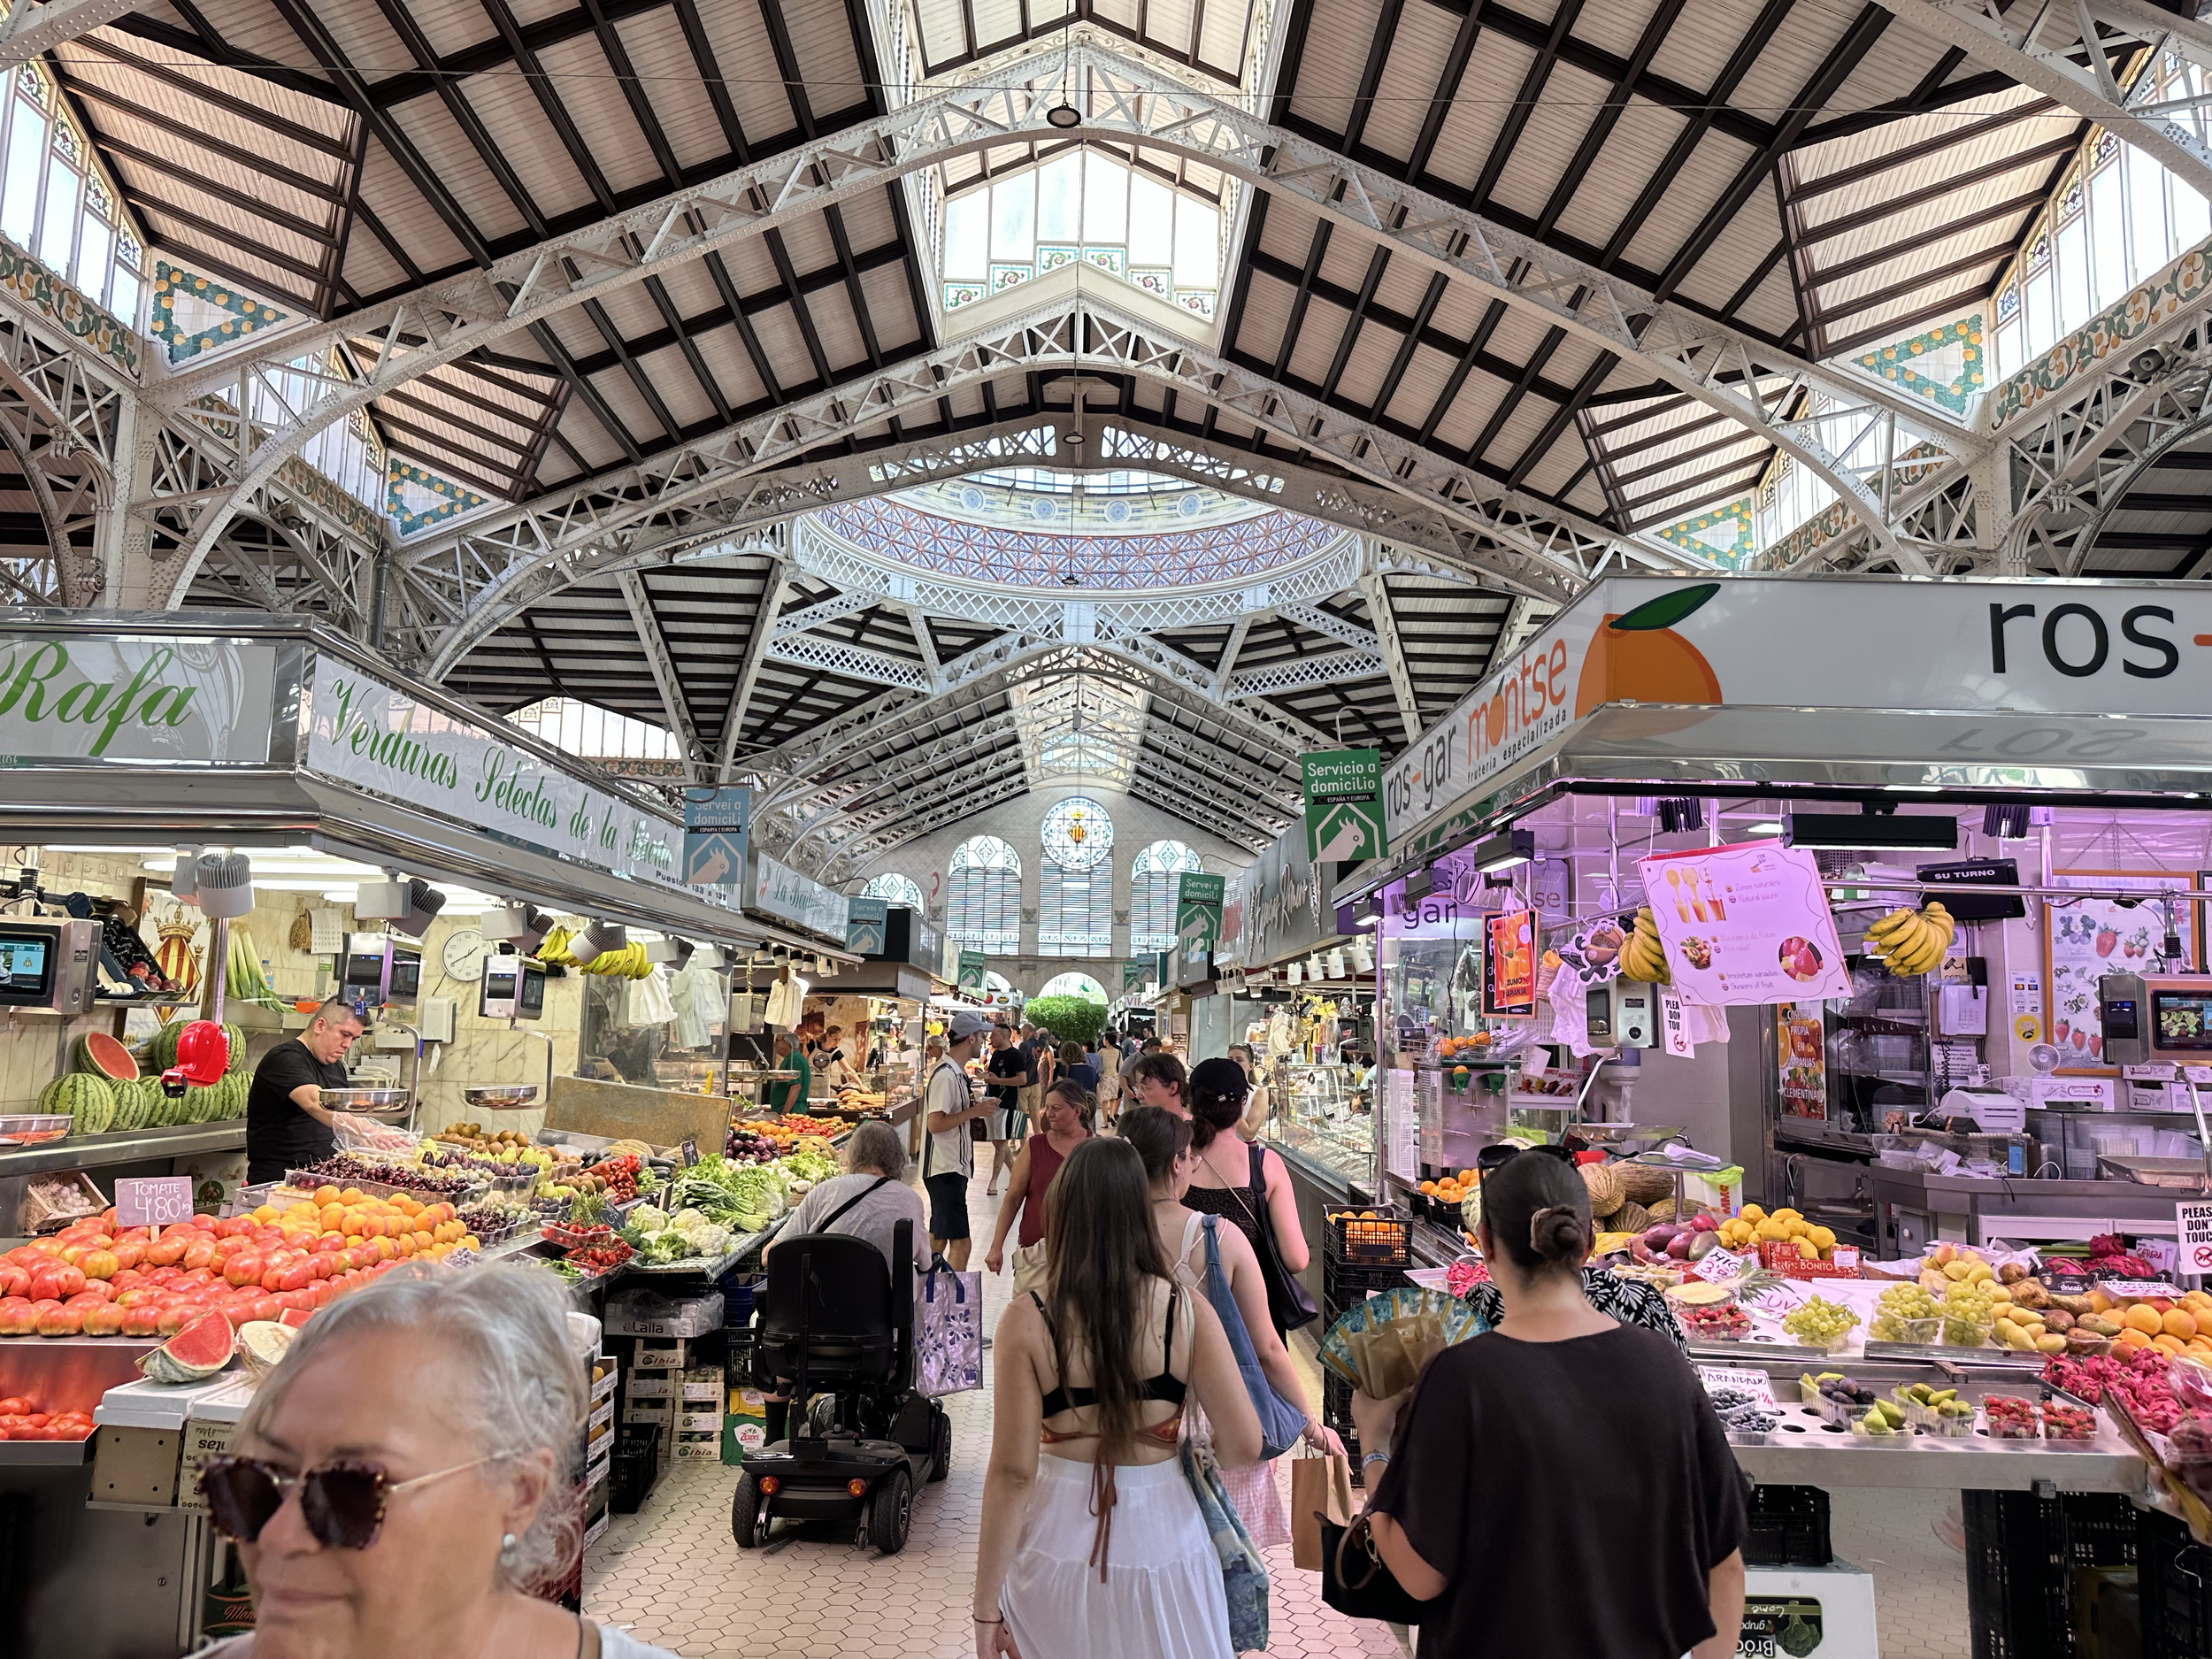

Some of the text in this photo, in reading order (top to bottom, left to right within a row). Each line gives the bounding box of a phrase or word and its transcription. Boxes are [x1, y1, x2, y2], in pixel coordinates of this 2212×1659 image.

[0, 640, 197, 757] Rafa
[1468, 638, 1567, 766] montse
[1503, 709, 1567, 761] especializada
[329, 679, 457, 789] Verduras
[475, 746, 557, 829] Selectas
[569, 793, 589, 840] de
[600, 805, 618, 851] la
[1308, 760, 1376, 777] Servicio a
[1387, 725, 1457, 821] ros-gar
[1310, 777, 1376, 793] domicilio
[695, 798, 731, 810] Servei
[694, 812, 741, 825] domicili
[1954, 869, 1995, 879] TURNO
[692, 884, 704, 895] 133
[1186, 879, 1212, 889] Servei
[1184, 888, 1218, 900] domicili
[854, 902, 876, 911] Servei
[853, 911, 883, 920] domicili
[1507, 977, 1523, 986] ZUMO
[1790, 1025, 1809, 1036] PROPIA
[1797, 1041, 1805, 1052] EN
[129, 1181, 180, 1195] TOMATE
[2187, 1219, 2212, 1231] DON'
[1800, 1261, 1833, 1272] BONITO
[632, 1321, 664, 1334] Laila
[1708, 1372, 1767, 1386] ARANDANO
[740, 1432, 760, 1441] Zespri
[1751, 1605, 1785, 1618] Come
